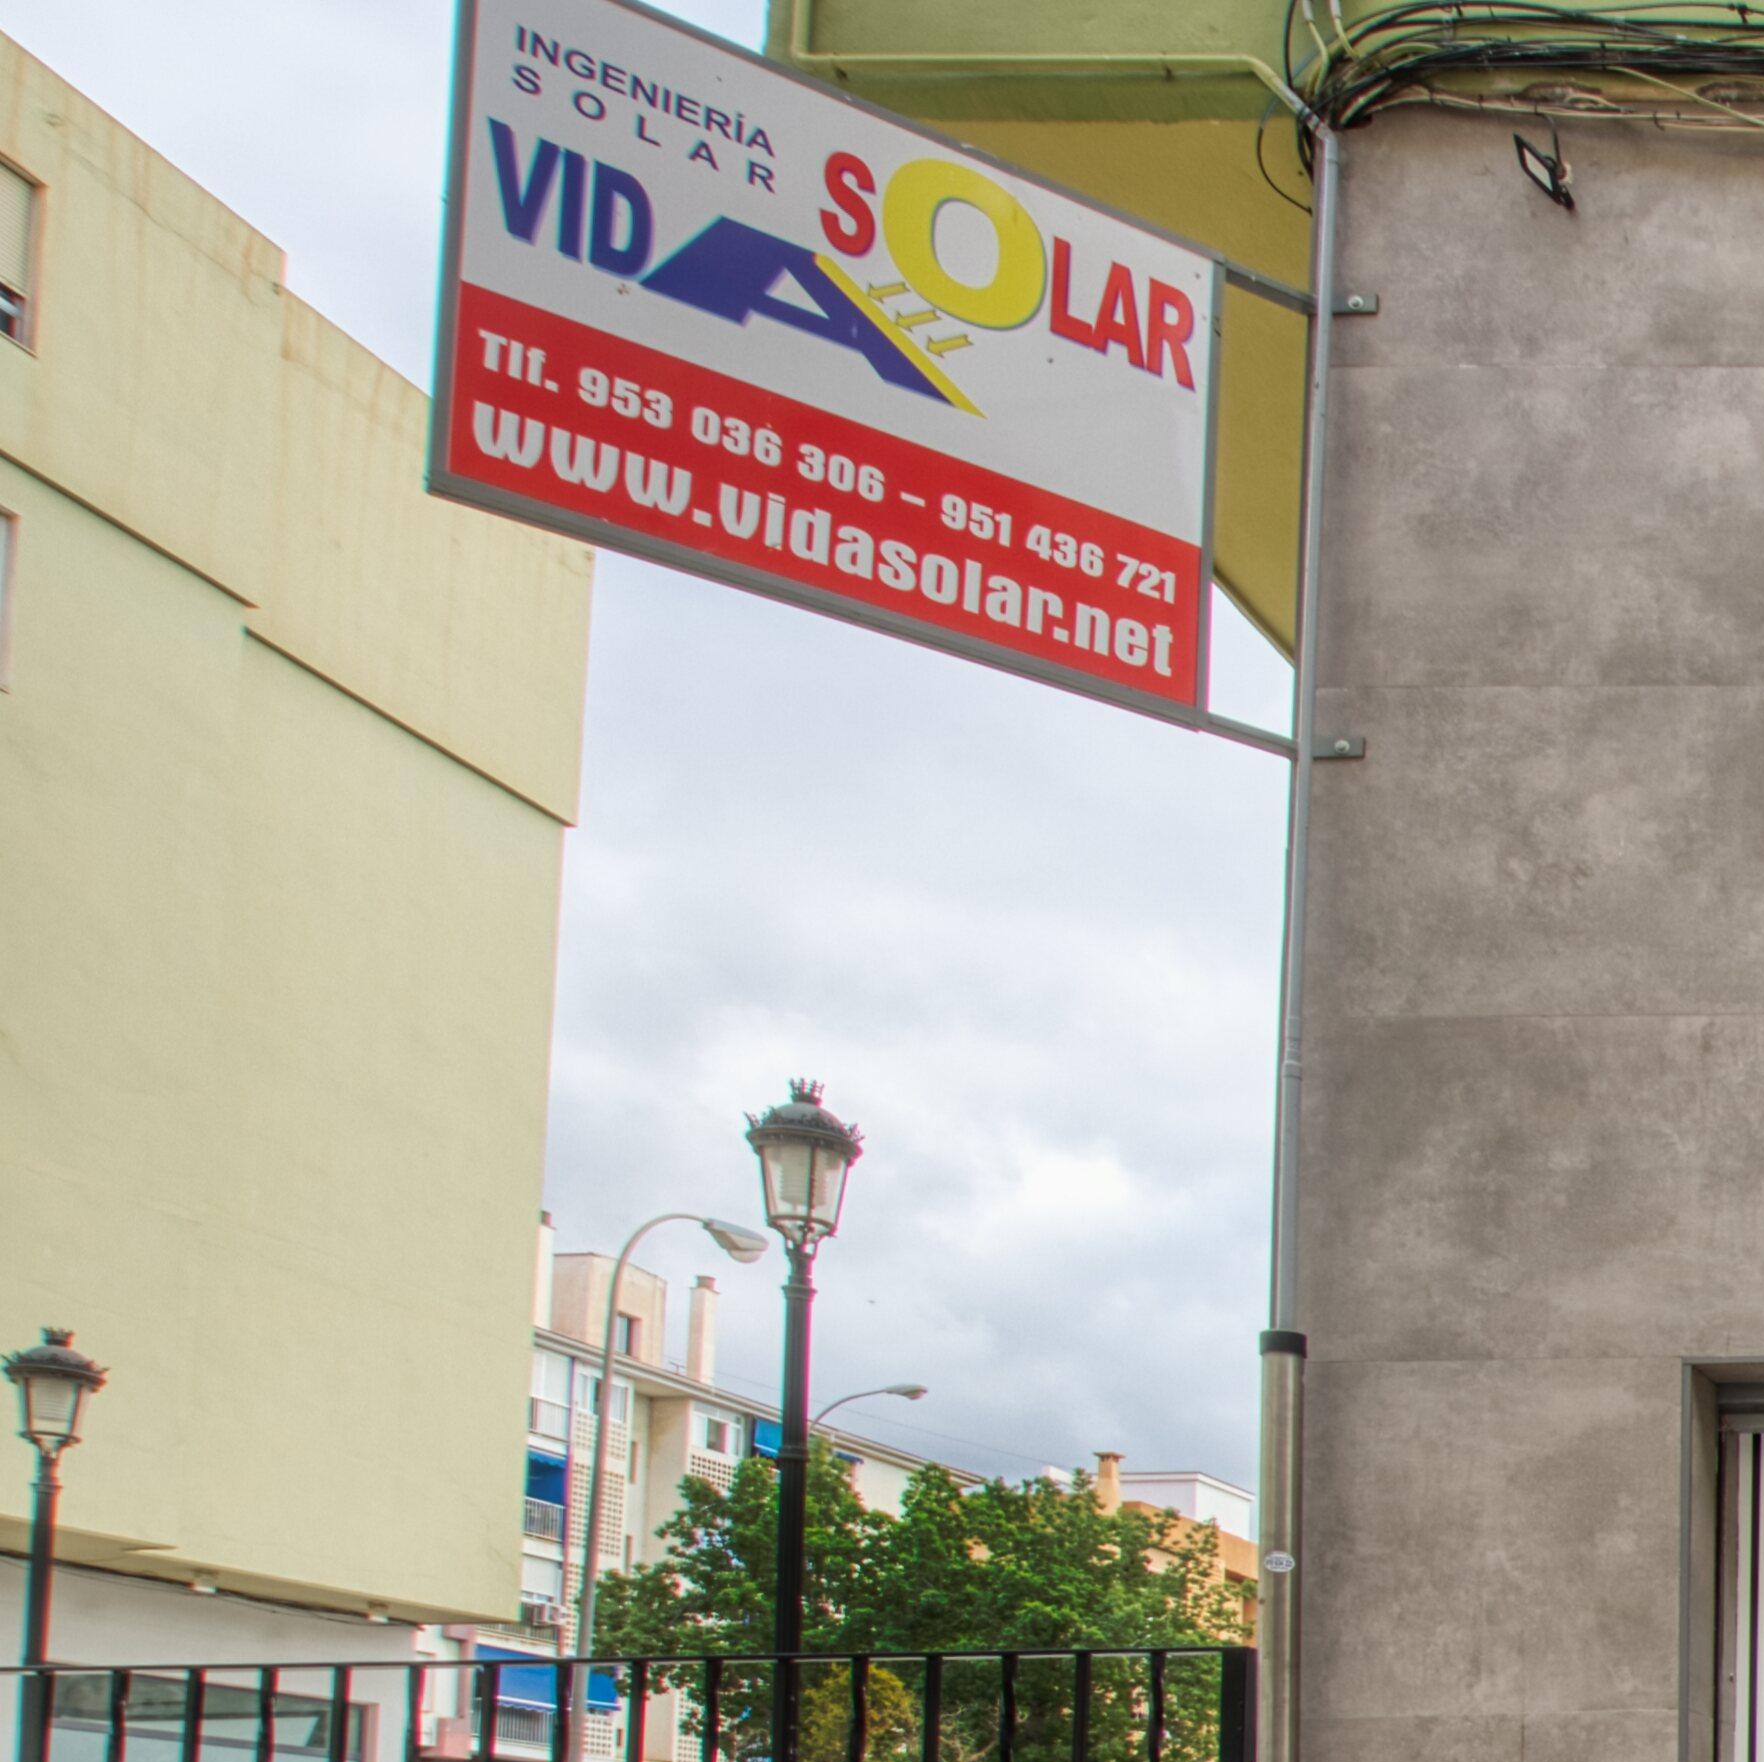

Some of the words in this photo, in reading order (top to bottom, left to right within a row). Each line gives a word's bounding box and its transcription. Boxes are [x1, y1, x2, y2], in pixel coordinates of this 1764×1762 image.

[511, 63, 777, 194] SOLAR
[515, 23, 778, 158] INGENIERÍA
[486, 116, 962, 410] VIDA
[818, 151, 1197, 394] SOLAR
[472, 400, 1175, 680] www.vidasolar.net
[478, 329, 561, 394] Tlf.
[578, 366, 675, 431] 953
[690, 409, 783, 468] 036
[796, 442, 887, 503] 306
[939, 494, 1013, 549] 951
[1025, 523, 1106, 579] 436
[1116, 552, 1178, 605] 721
